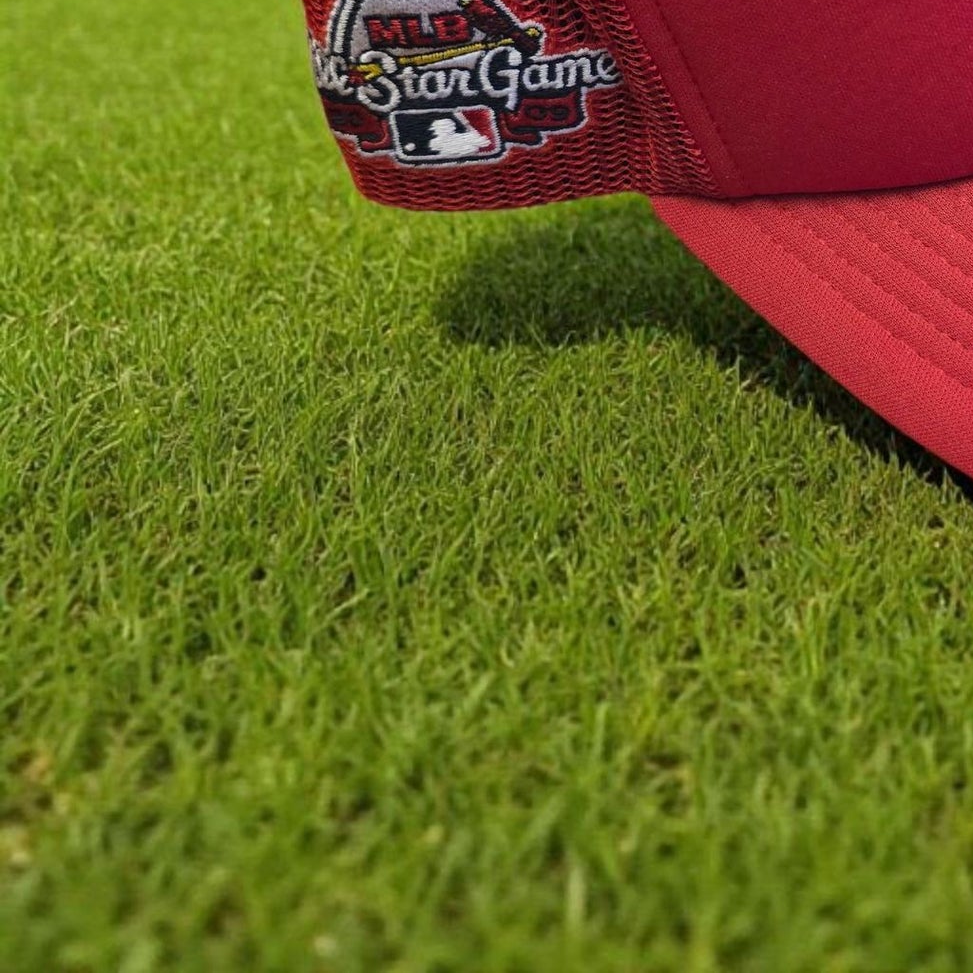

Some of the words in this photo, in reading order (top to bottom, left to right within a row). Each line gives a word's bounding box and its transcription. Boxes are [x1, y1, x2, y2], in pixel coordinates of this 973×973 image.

[367, 13, 471, 45] MLB
[356, 49, 480, 113] Star
[479, 45, 621, 111] Game
